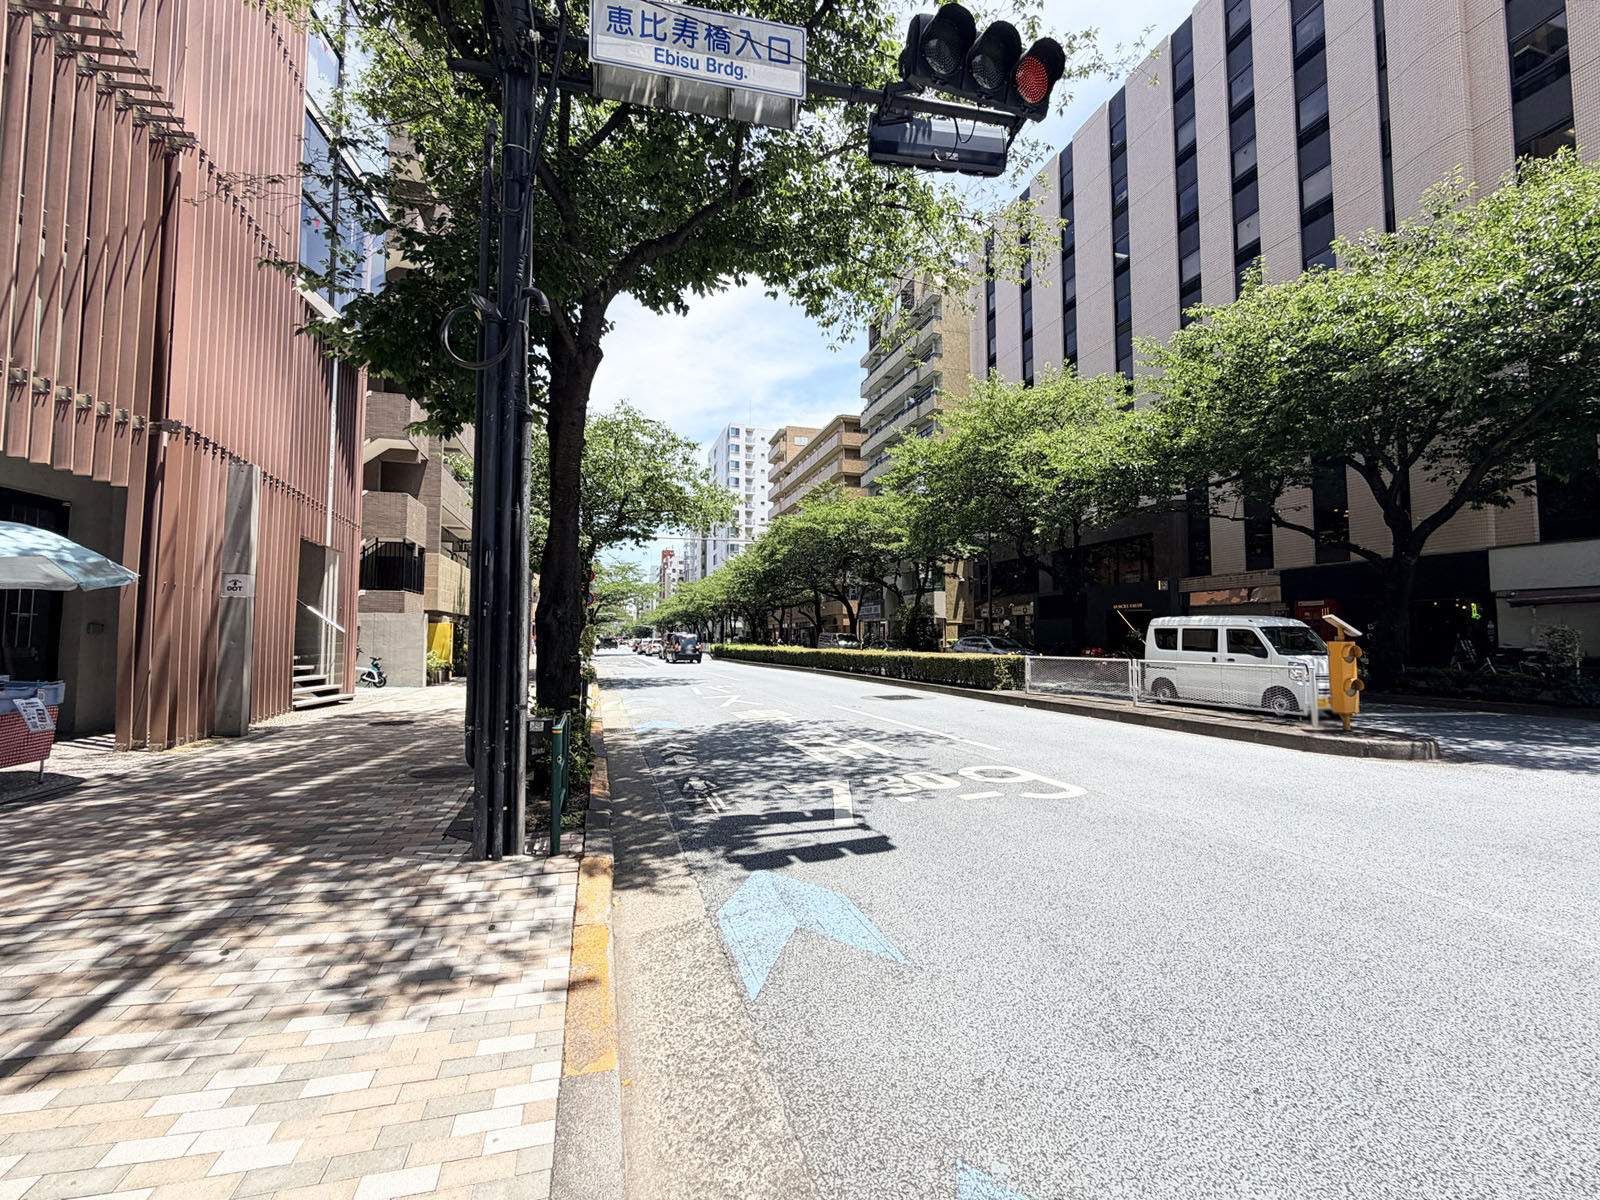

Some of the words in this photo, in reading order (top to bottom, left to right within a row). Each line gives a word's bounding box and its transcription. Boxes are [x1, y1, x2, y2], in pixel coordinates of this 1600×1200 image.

[606, 5, 791, 65] 恵比寿橋入口
[653, 47, 700, 71] Ebisu
[705, 59, 749, 80] Brdg.
